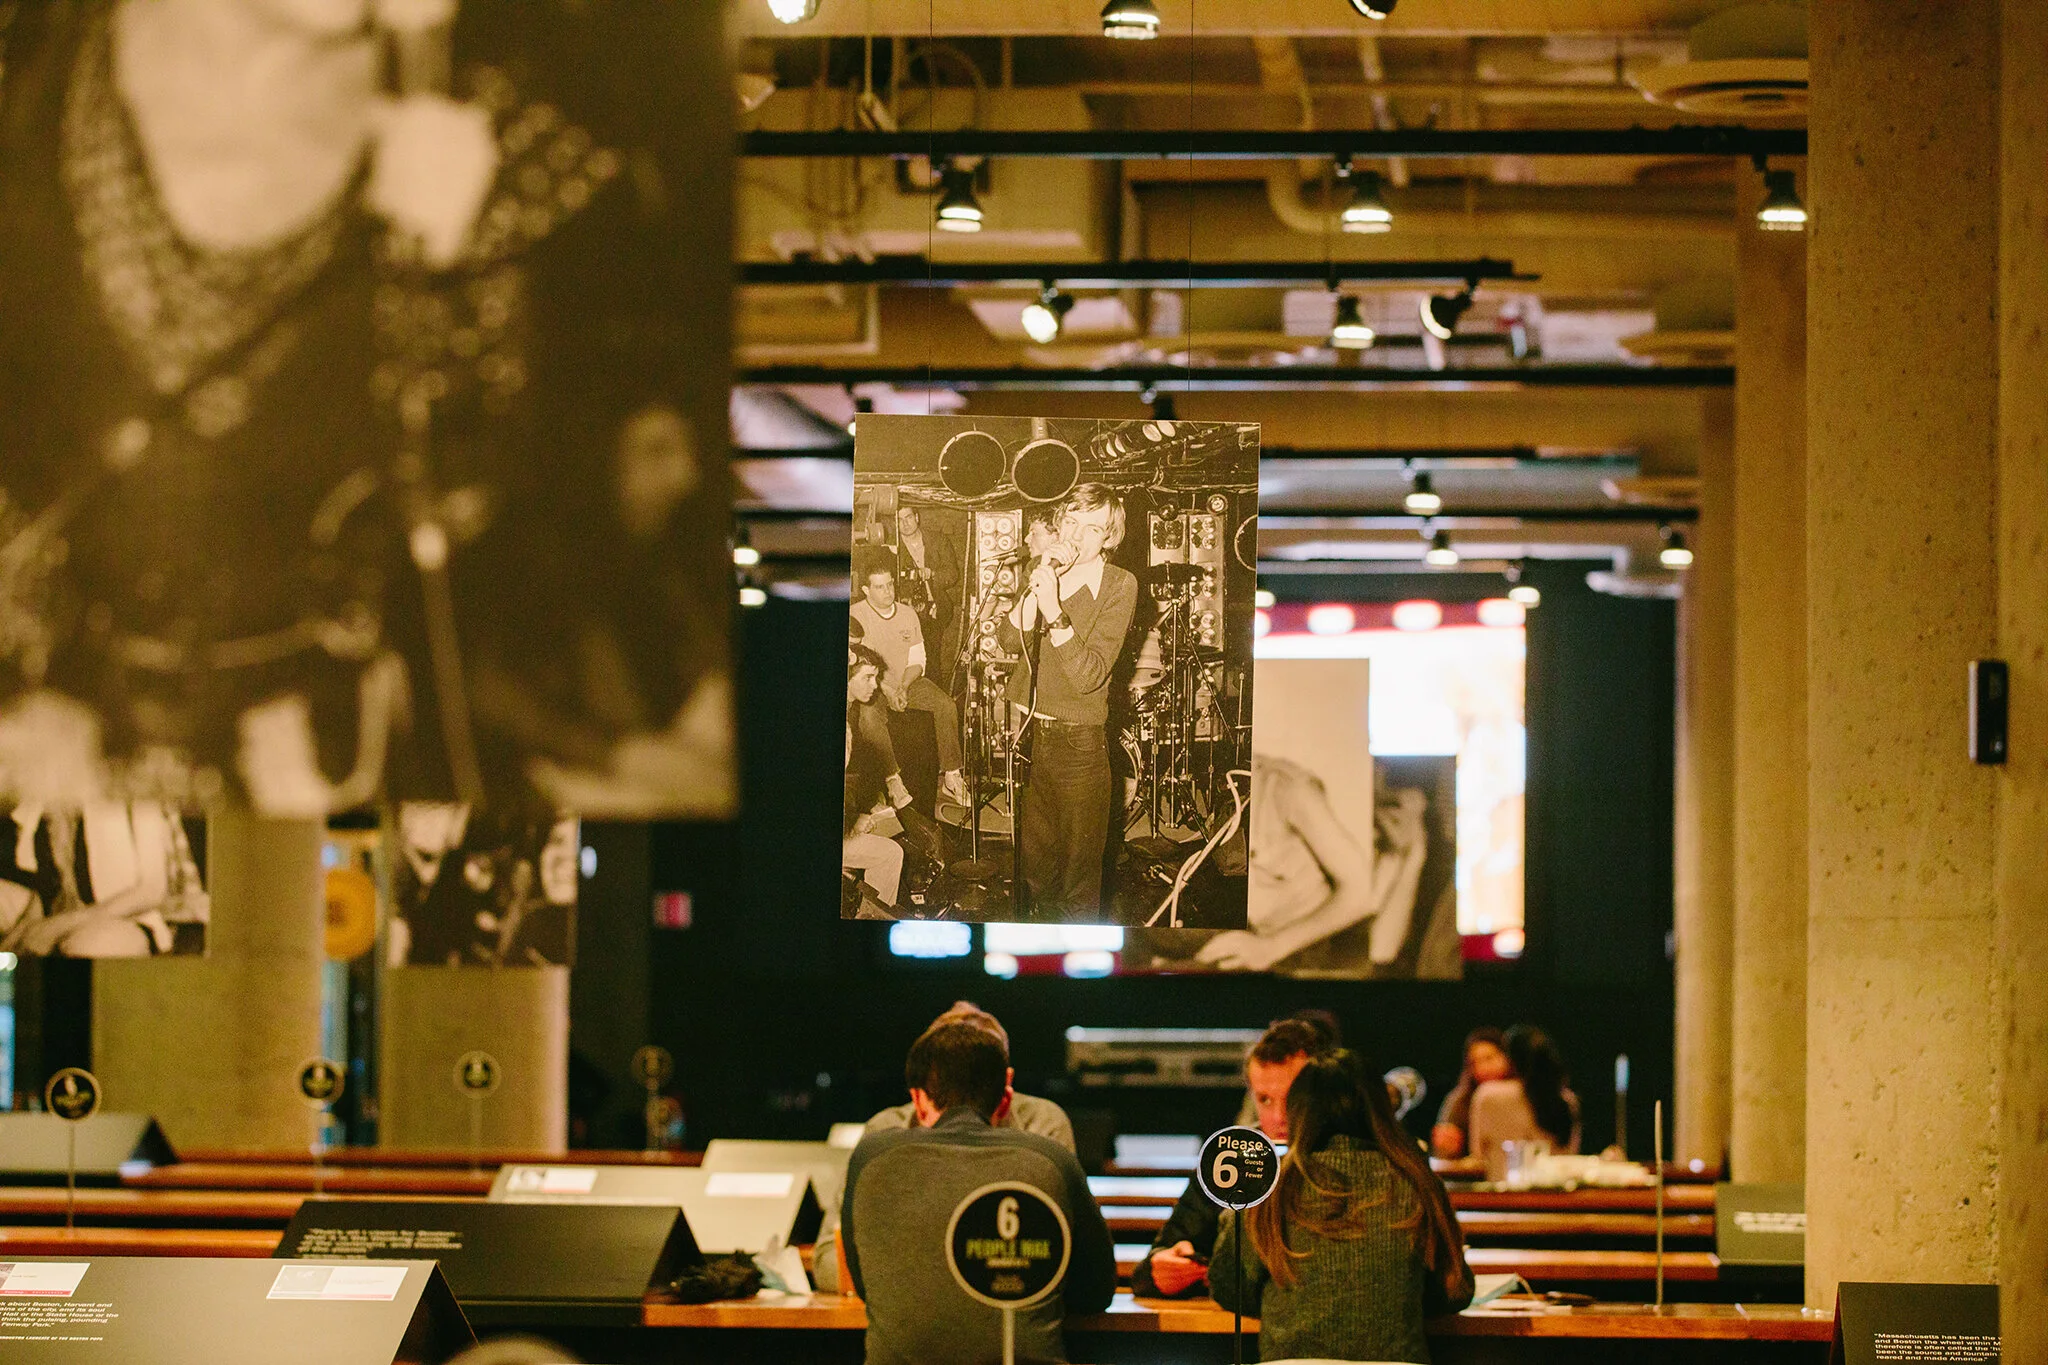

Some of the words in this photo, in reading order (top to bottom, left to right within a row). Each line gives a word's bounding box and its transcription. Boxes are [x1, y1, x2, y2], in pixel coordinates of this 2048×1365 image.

[1218, 1136, 1264, 1152] Please
[1212, 1150, 1238, 1189] 6
[1244, 1158, 1264, 1166] Guests
[996, 1196, 1020, 1240] 6
